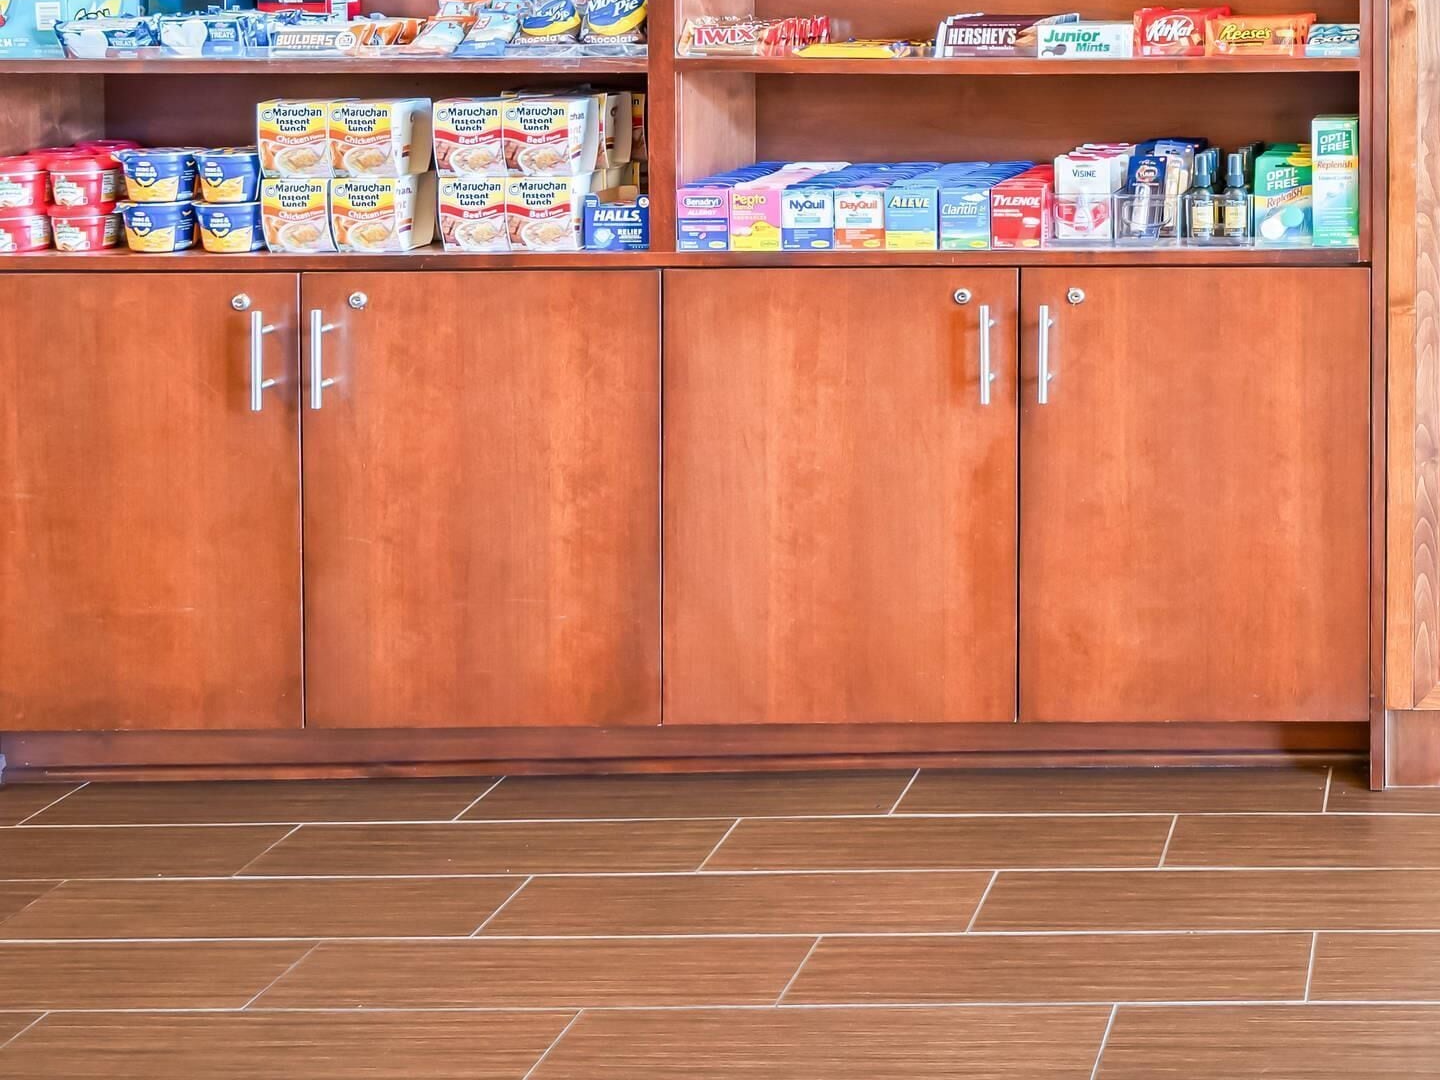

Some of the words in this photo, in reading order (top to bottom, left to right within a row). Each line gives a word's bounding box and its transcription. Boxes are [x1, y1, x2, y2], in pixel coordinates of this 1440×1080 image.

[693, 26, 756, 46] TWIX
[949, 27, 1017, 45] HERSHEY'S
[1043, 29, 1100, 43] Junior
[1219, 24, 1272, 40] Reese's
[276, 34, 337, 46] BUILDERS
[584, 35, 639, 44] Chocolate
[1309, 34, 1359, 45] Extra
[1075, 42, 1111, 52] Mints
[273, 108, 322, 118] Maruchan
[341, 108, 388, 118] Maruchan
[448, 107, 498, 116] Maruchan
[517, 107, 565, 116] Maruchan
[276, 134, 310, 145] Chicken
[344, 134, 376, 145] Chicken
[1319, 131, 1349, 144] OPTI-
[1320, 141, 1350, 153] FREE
[1072, 169, 1096, 178] VISINE
[1266, 167, 1298, 181] OPTI-
[275, 183, 322, 193] Maruchan
[344, 183, 391, 193] Maruchan
[453, 182, 501, 191] Maruchan
[519, 182, 567, 191] Maruchan
[1267, 178, 1299, 191] FREE
[686, 198, 719, 208] Benadryl
[733, 194, 766, 208] Pepto
[789, 200, 825, 211] NyQuil
[840, 200, 877, 211] DayQuil
[888, 195, 929, 209] ALEVE
[993, 194, 1040, 207] TYLENOL
[942, 202, 977, 215] Claritin
[278, 210, 310, 219] Chicken
[348, 210, 379, 219] Chicken
[594, 210, 640, 221] HALLS
